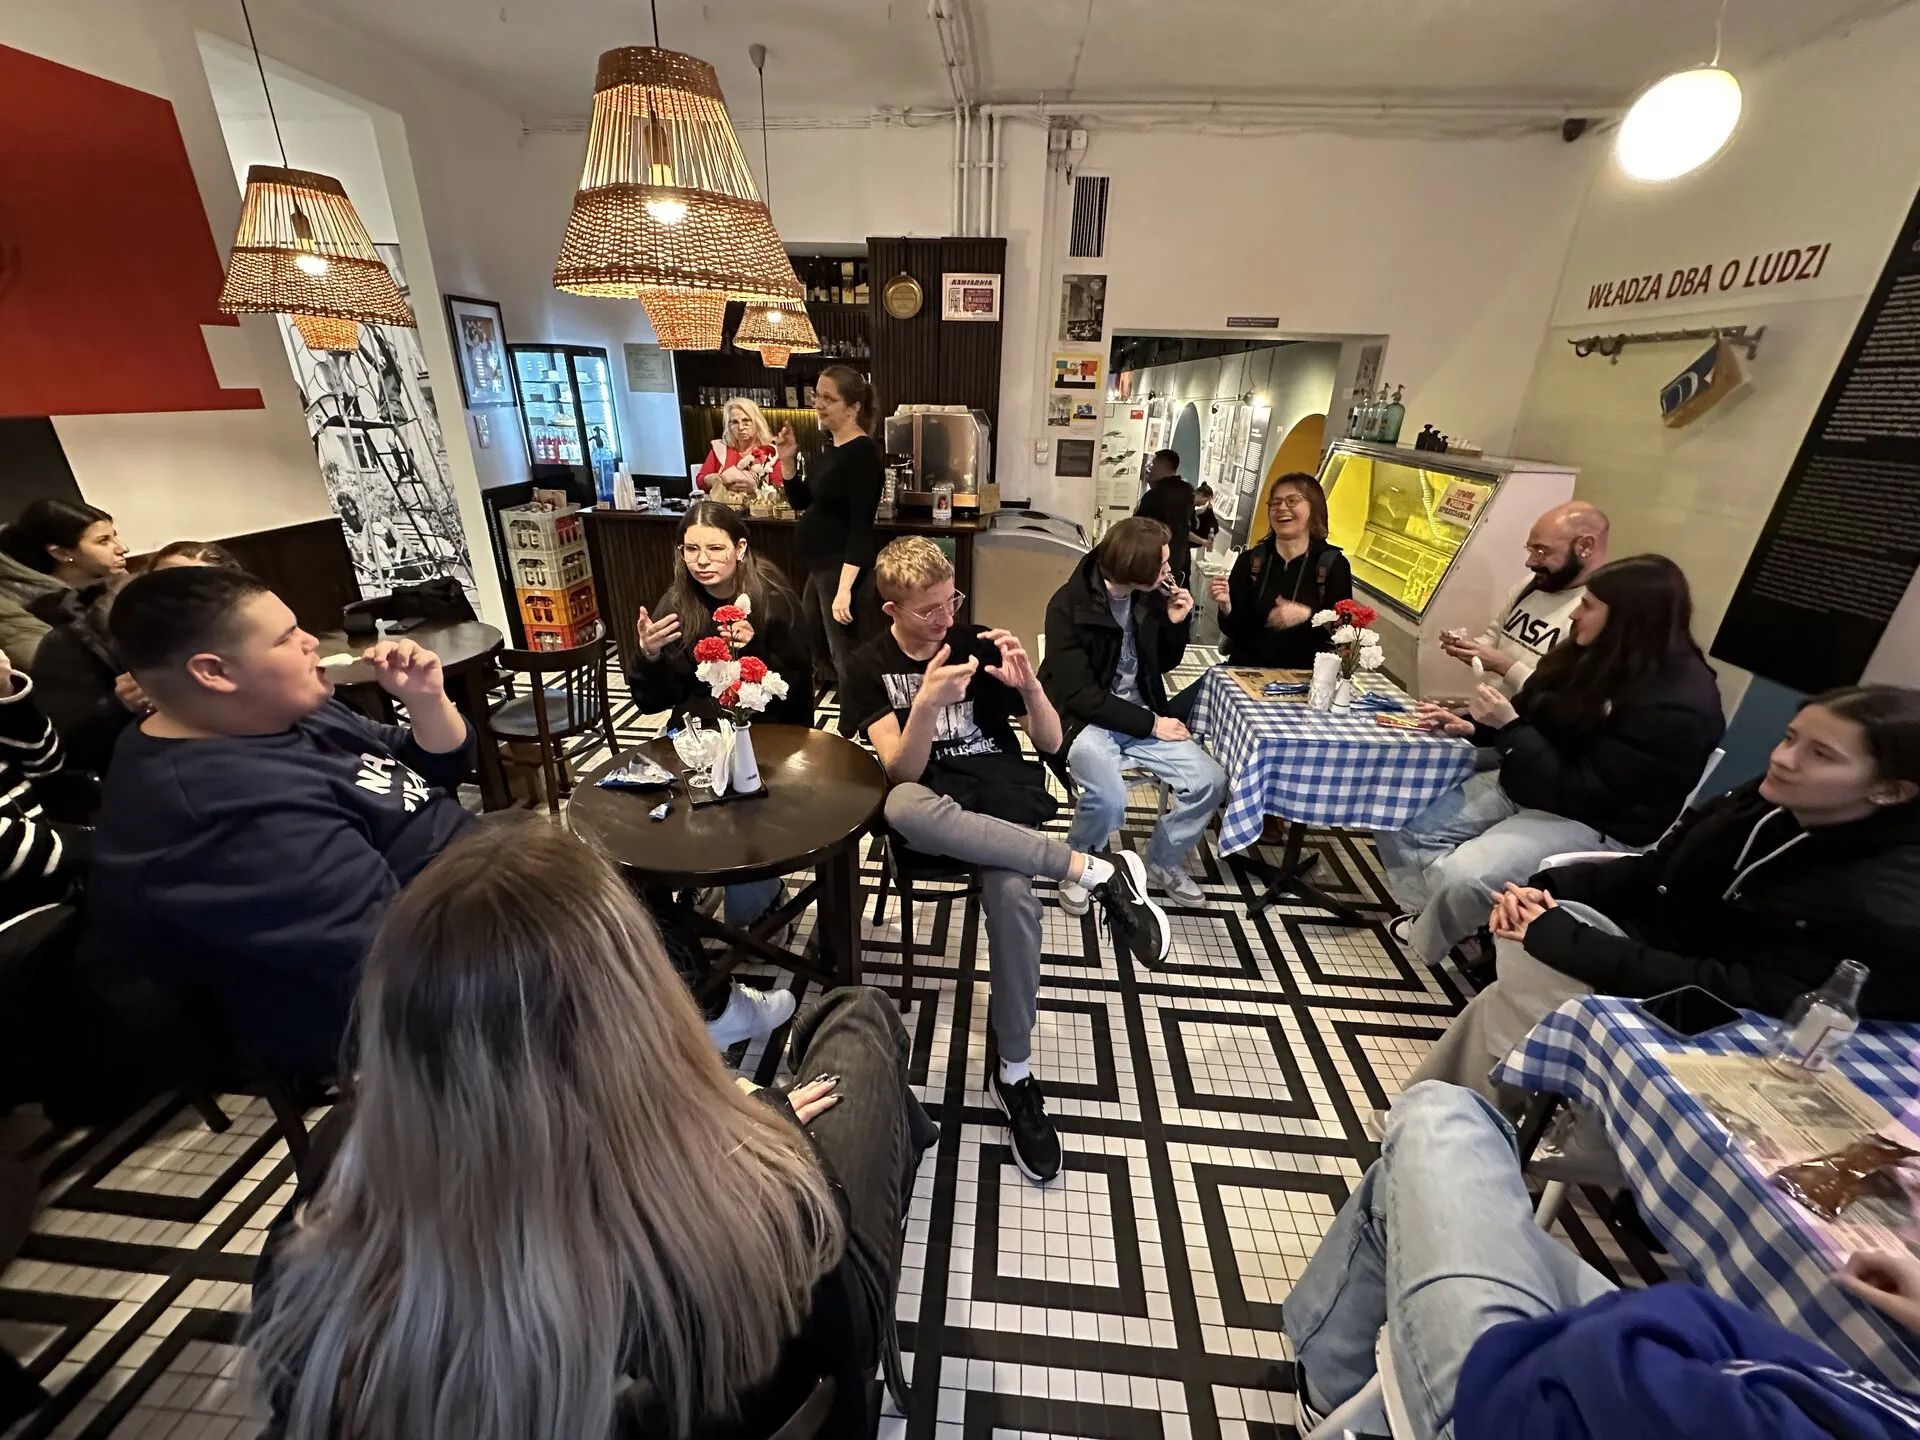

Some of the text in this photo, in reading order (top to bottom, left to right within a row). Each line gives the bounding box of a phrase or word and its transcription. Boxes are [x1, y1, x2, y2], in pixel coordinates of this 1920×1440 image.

[1587, 243, 1831, 309] WŁADZA DBA O LUDZI
[1503, 609, 1560, 653] NASA
